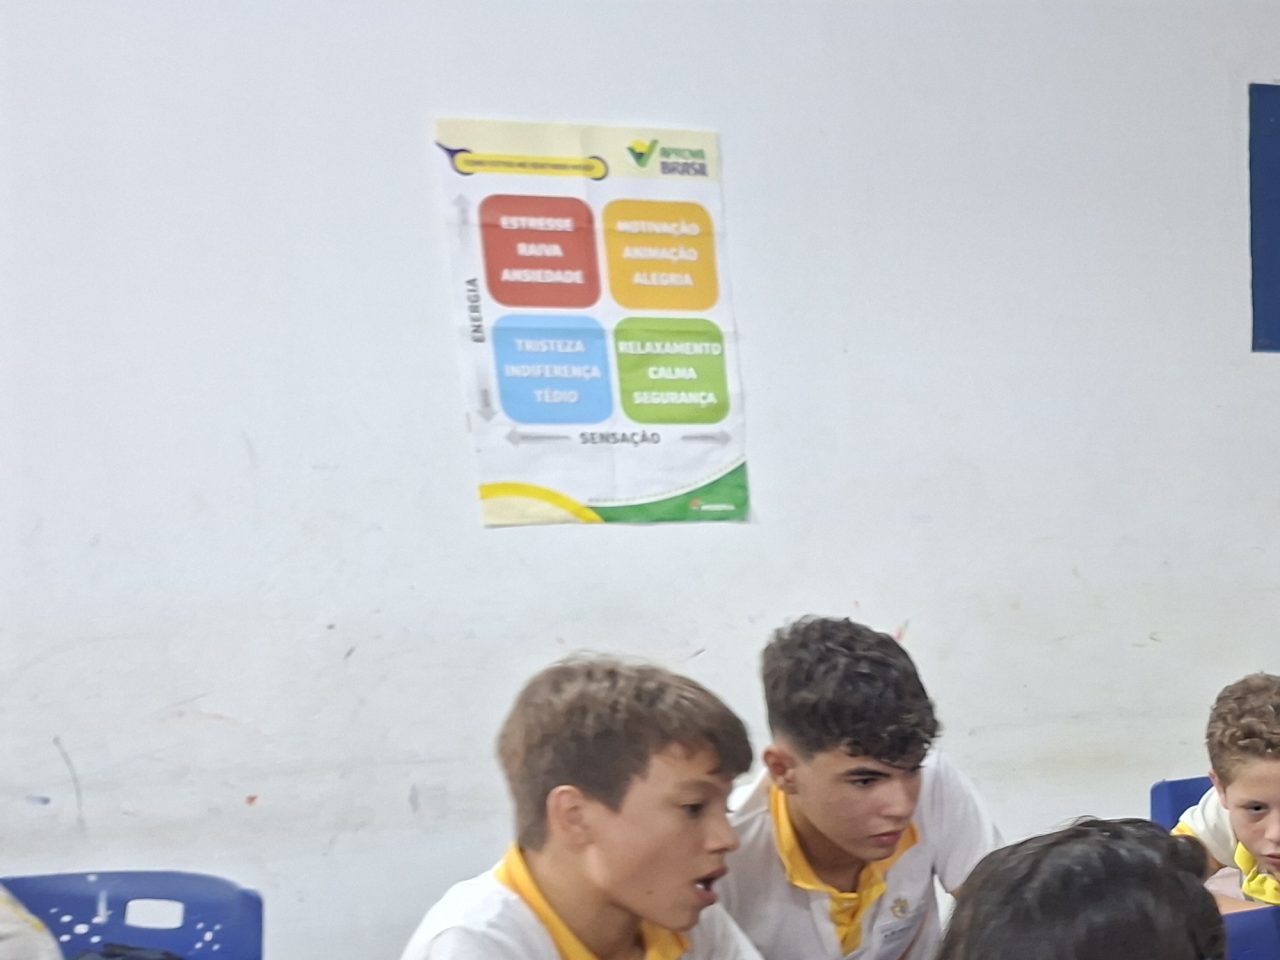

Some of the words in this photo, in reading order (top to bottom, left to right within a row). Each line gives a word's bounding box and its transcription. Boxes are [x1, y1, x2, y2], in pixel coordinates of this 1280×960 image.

[500, 216, 575, 232] ESTRESSE
[516, 242, 564, 258] RAIVA
[501, 268, 585, 285] ANSIEDADE
[633, 271, 694, 287] ALEGRIA
[464, 277, 486, 344] ENERGIA
[513, 338, 587, 354] TRISTEZA
[618, 341, 722, 356] RELAXAMENTO
[504, 364, 602, 382] INDIFERENÇA
[647, 366, 698, 380] CALMA
[533, 386, 579, 404] TÉDIO
[633, 390, 718, 409] SEGURANÇA
[579, 430, 661, 448] SENSAÇÃO
